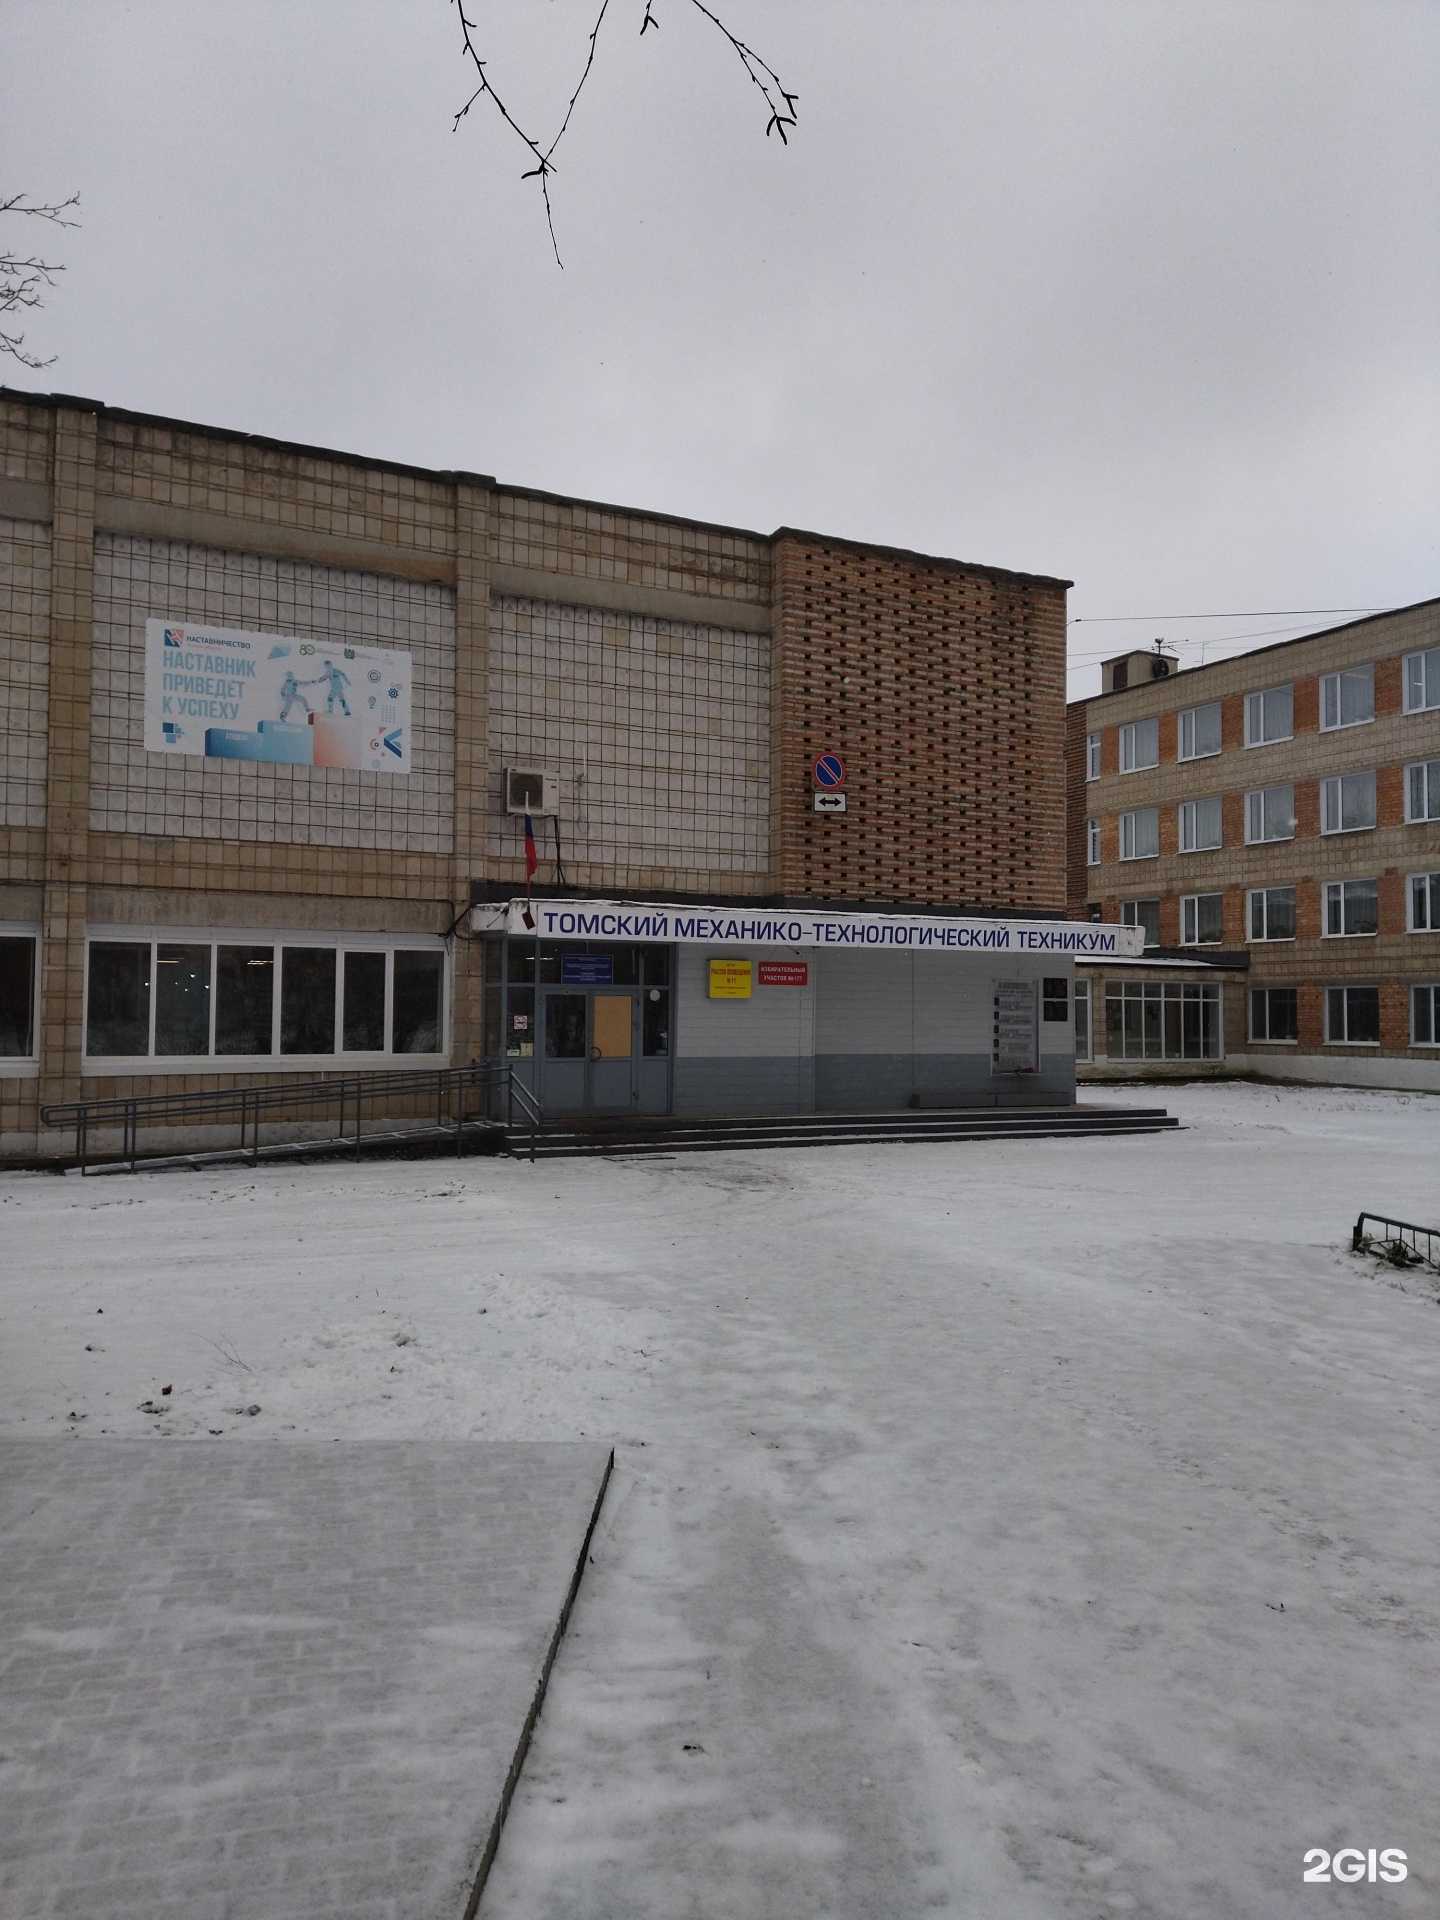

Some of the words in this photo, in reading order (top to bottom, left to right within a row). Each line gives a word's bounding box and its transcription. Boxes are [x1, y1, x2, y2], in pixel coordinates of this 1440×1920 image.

[186, 636, 251, 649] НАСТАВНИЧЕСТВО
[162, 650, 256, 678] НАСТАВНИК
[162, 673, 246, 700] ПРИВЕДЕТ
[162, 696, 173, 714] К
[177, 698, 240, 720] УСПЕХУ
[543, 911, 668, 937] ТОМСКИЙ
[674, 917, 1010, 948] МЕХАНИКО-ТЕХНОЛОГИЧЕСКИЙ
[1017, 930, 1116, 950] ТЕХНИКУМ
